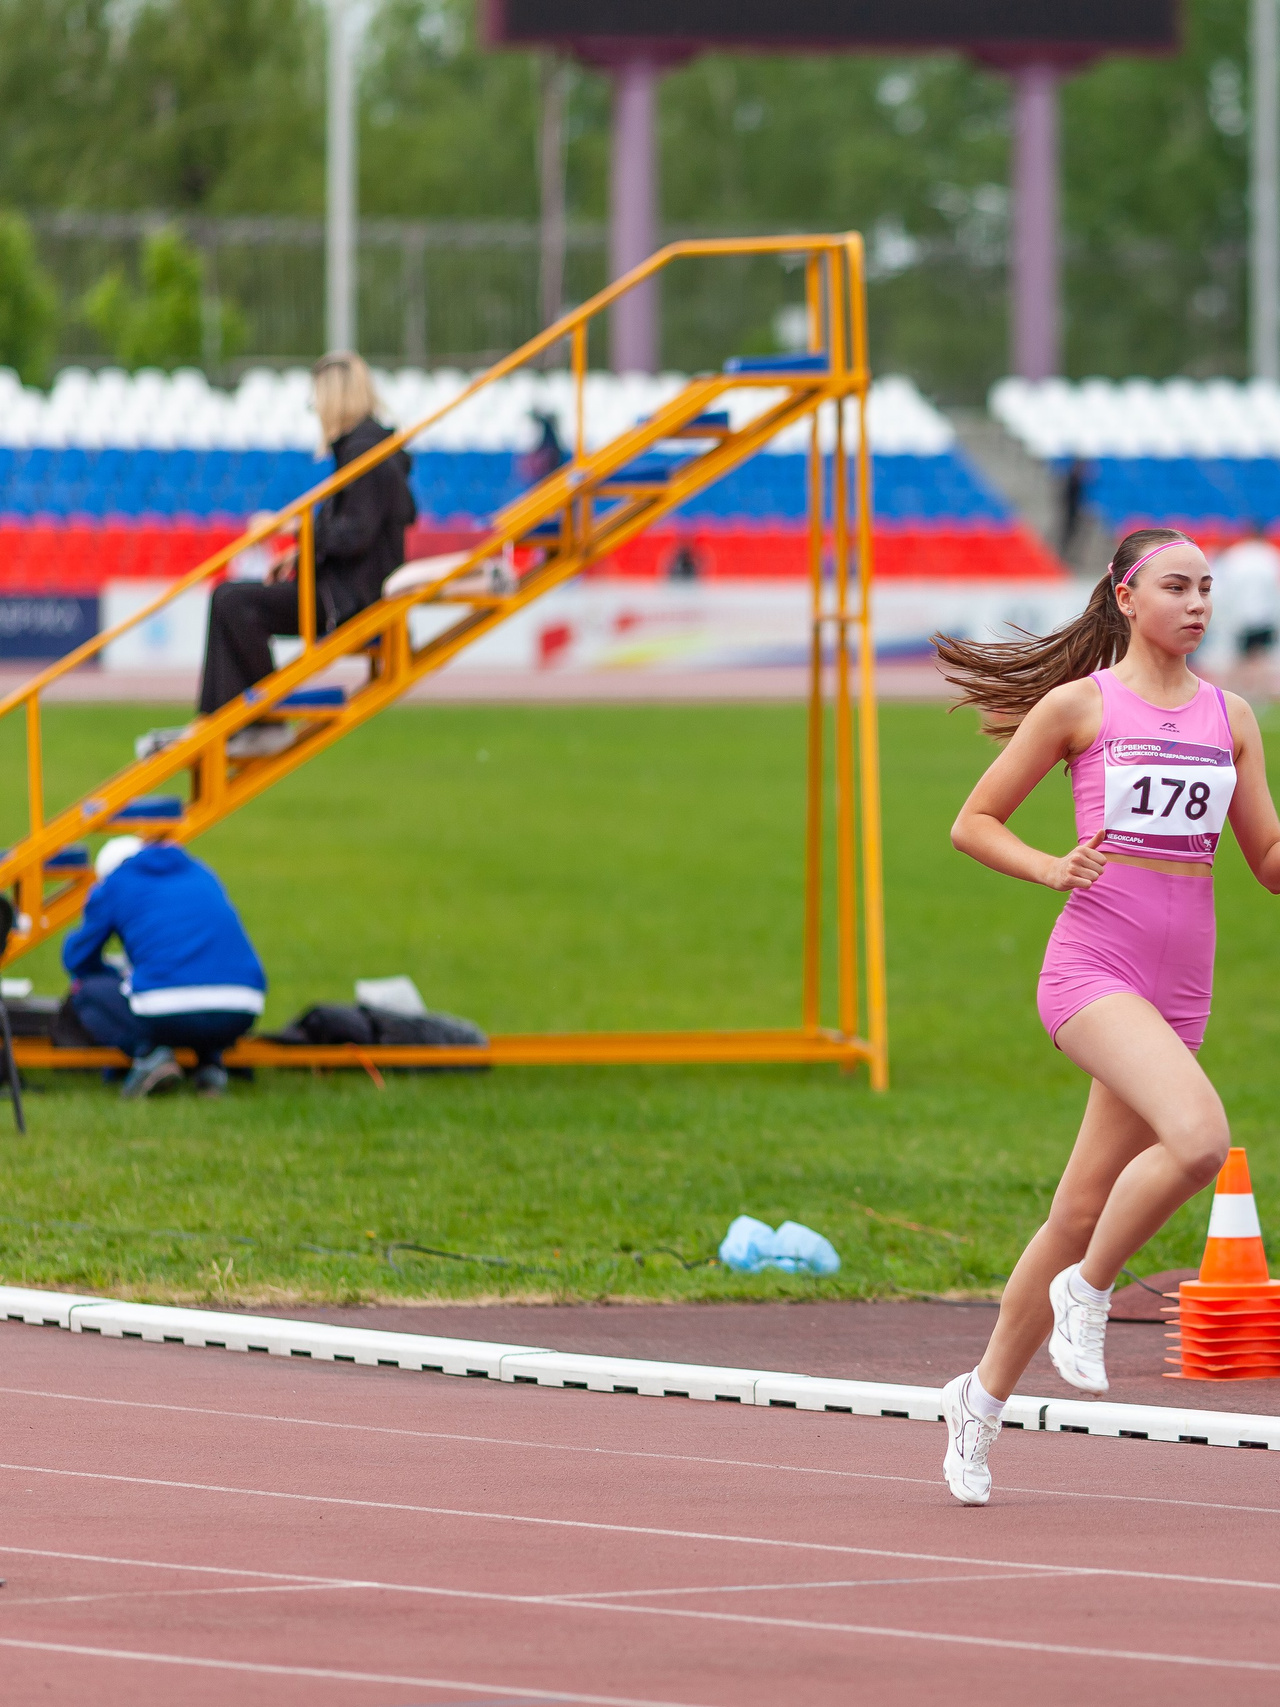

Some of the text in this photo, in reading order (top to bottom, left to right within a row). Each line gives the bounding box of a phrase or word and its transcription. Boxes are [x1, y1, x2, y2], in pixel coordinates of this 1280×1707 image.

[1113, 744, 1161, 753] ПЕРВЕНСТВО
[1159, 753, 1200, 761] ФЕДЕРАЛЬНОГО
[1199, 757, 1218, 765] ОКРУГА
[1131, 776, 1210, 820] 178
[1106, 833, 1144, 844] ЧЕБОКСАРЫ
